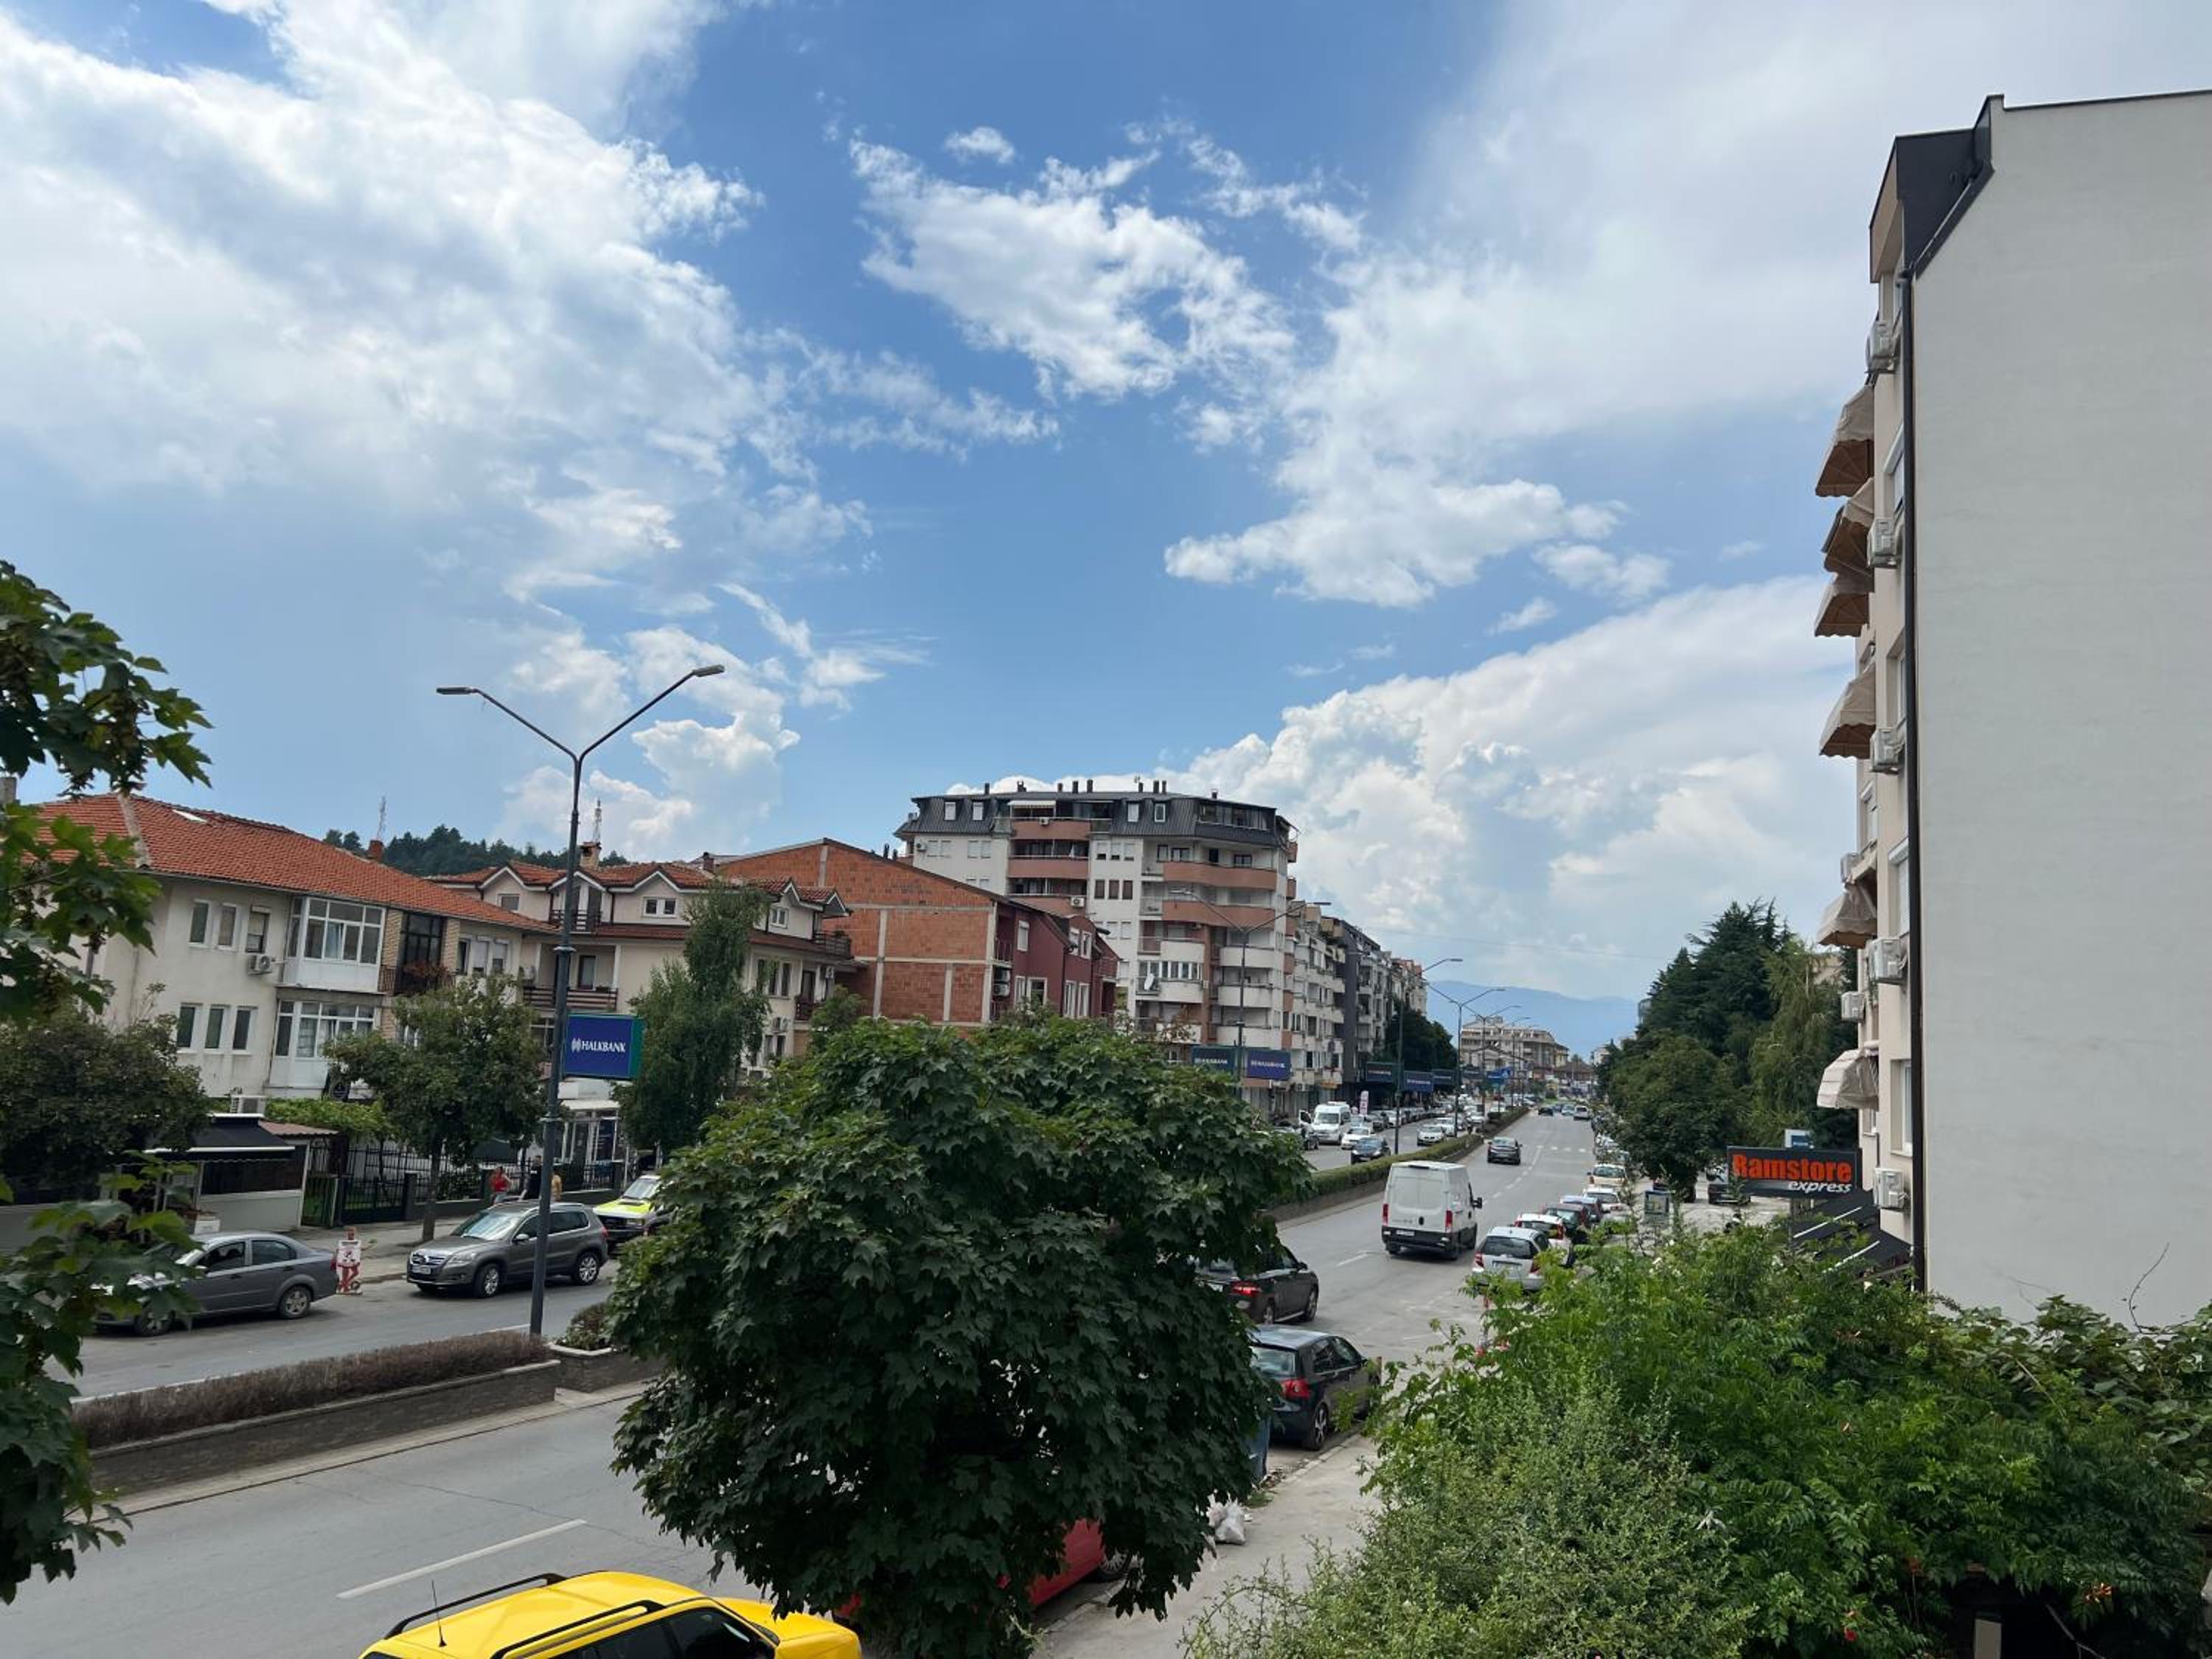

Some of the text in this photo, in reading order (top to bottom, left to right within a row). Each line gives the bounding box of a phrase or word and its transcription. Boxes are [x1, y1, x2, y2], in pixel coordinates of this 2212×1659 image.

[582, 1040, 626, 1053] HALKBANK
[1733, 1153, 1852, 1182] Ramstore
[1788, 1181, 1852, 1194] express
